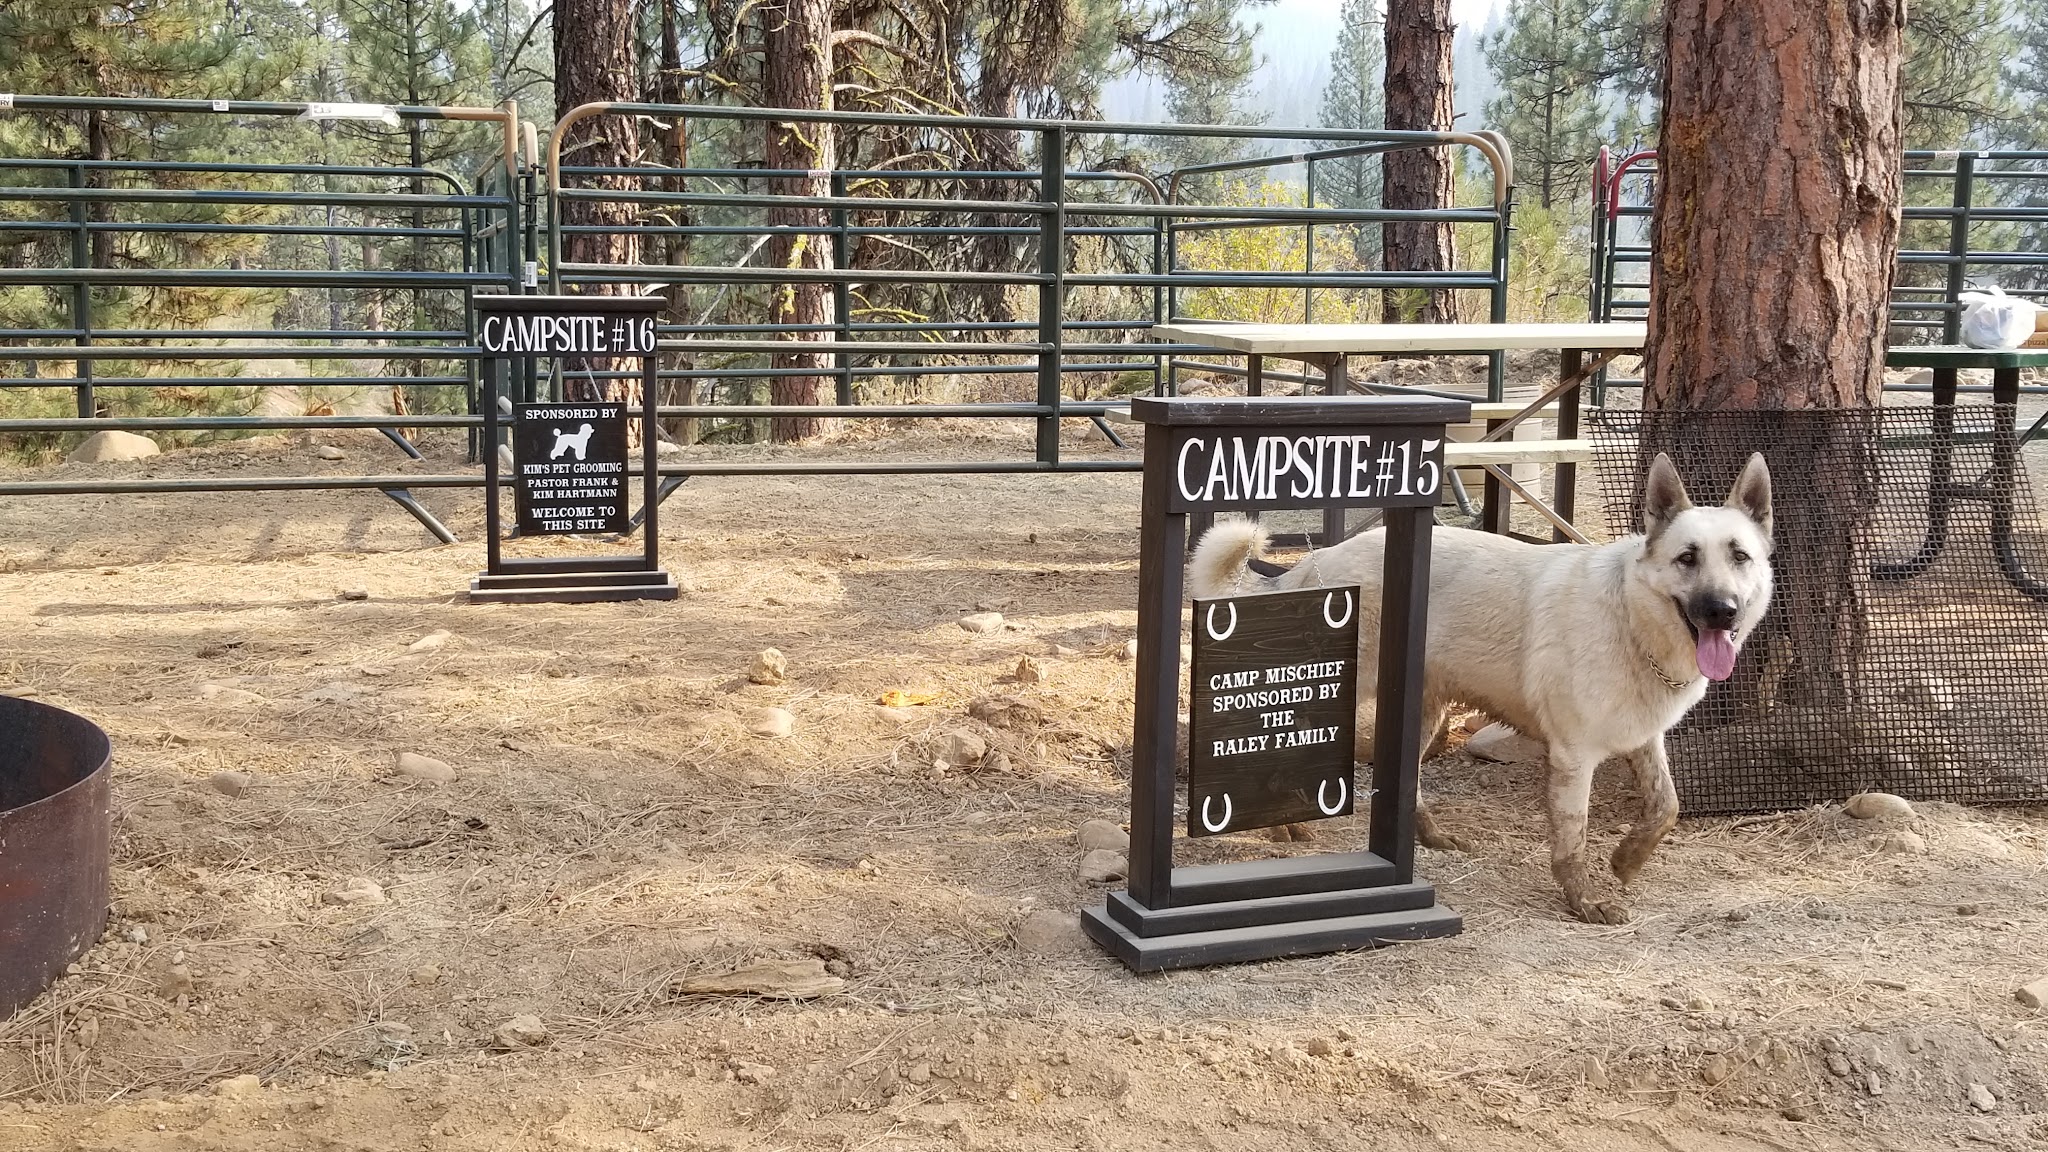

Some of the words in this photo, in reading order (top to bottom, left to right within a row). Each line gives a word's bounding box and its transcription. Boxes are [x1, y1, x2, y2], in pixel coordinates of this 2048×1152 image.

[483, 316, 608, 352] CAMPSITE
[612, 317, 656, 352] #16
[525, 409, 598, 420] SPONSORED
[601, 408, 618, 418] BY
[523, 464, 550, 474] KIM'S
[552, 463, 571, 474] PET
[573, 462, 623, 473] GROOMING
[1177, 435, 1371, 501] CAMPSITE
[1375, 438, 1441, 497] #15
[527, 478, 569, 488] PASTOR
[572, 477, 609, 487] FRANK
[611, 477, 619, 485] &
[532, 490, 554, 499] KIM
[556, 489, 617, 499] HARTMANN
[531, 506, 595, 518] WELCOME
[598, 506, 616, 516] TO
[542, 520, 573, 531] THIS
[577, 519, 606, 530] SITE
[1210, 670, 1259, 690] CAMP
[1265, 660, 1345, 685] MISCHIEF
[1212, 686, 1313, 713] SPONSORED
[1318, 683, 1341, 700] BY
[1260, 710, 1295, 728] THE
[1212, 735, 1270, 757] RALEY
[1274, 726, 1339, 749] FAMILY
